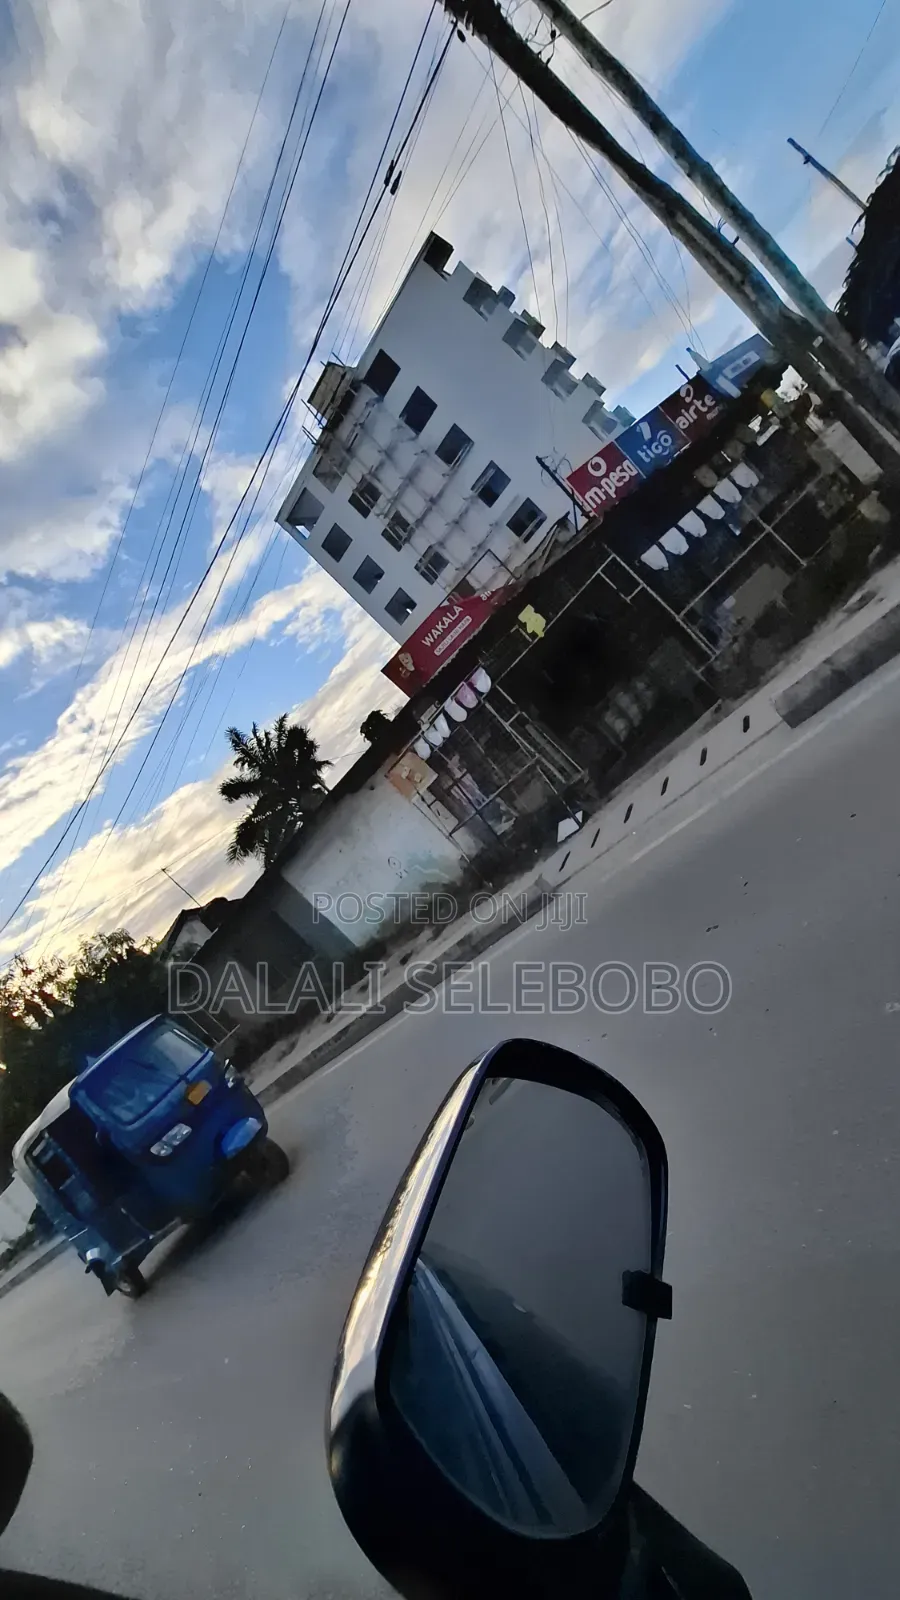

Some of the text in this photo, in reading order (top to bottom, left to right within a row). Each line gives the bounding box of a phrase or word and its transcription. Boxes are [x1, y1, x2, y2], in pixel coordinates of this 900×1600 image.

[676, 394, 716, 429] airte
[637, 430, 673, 463] tigo
[421, 605, 464, 647] WAKALA
